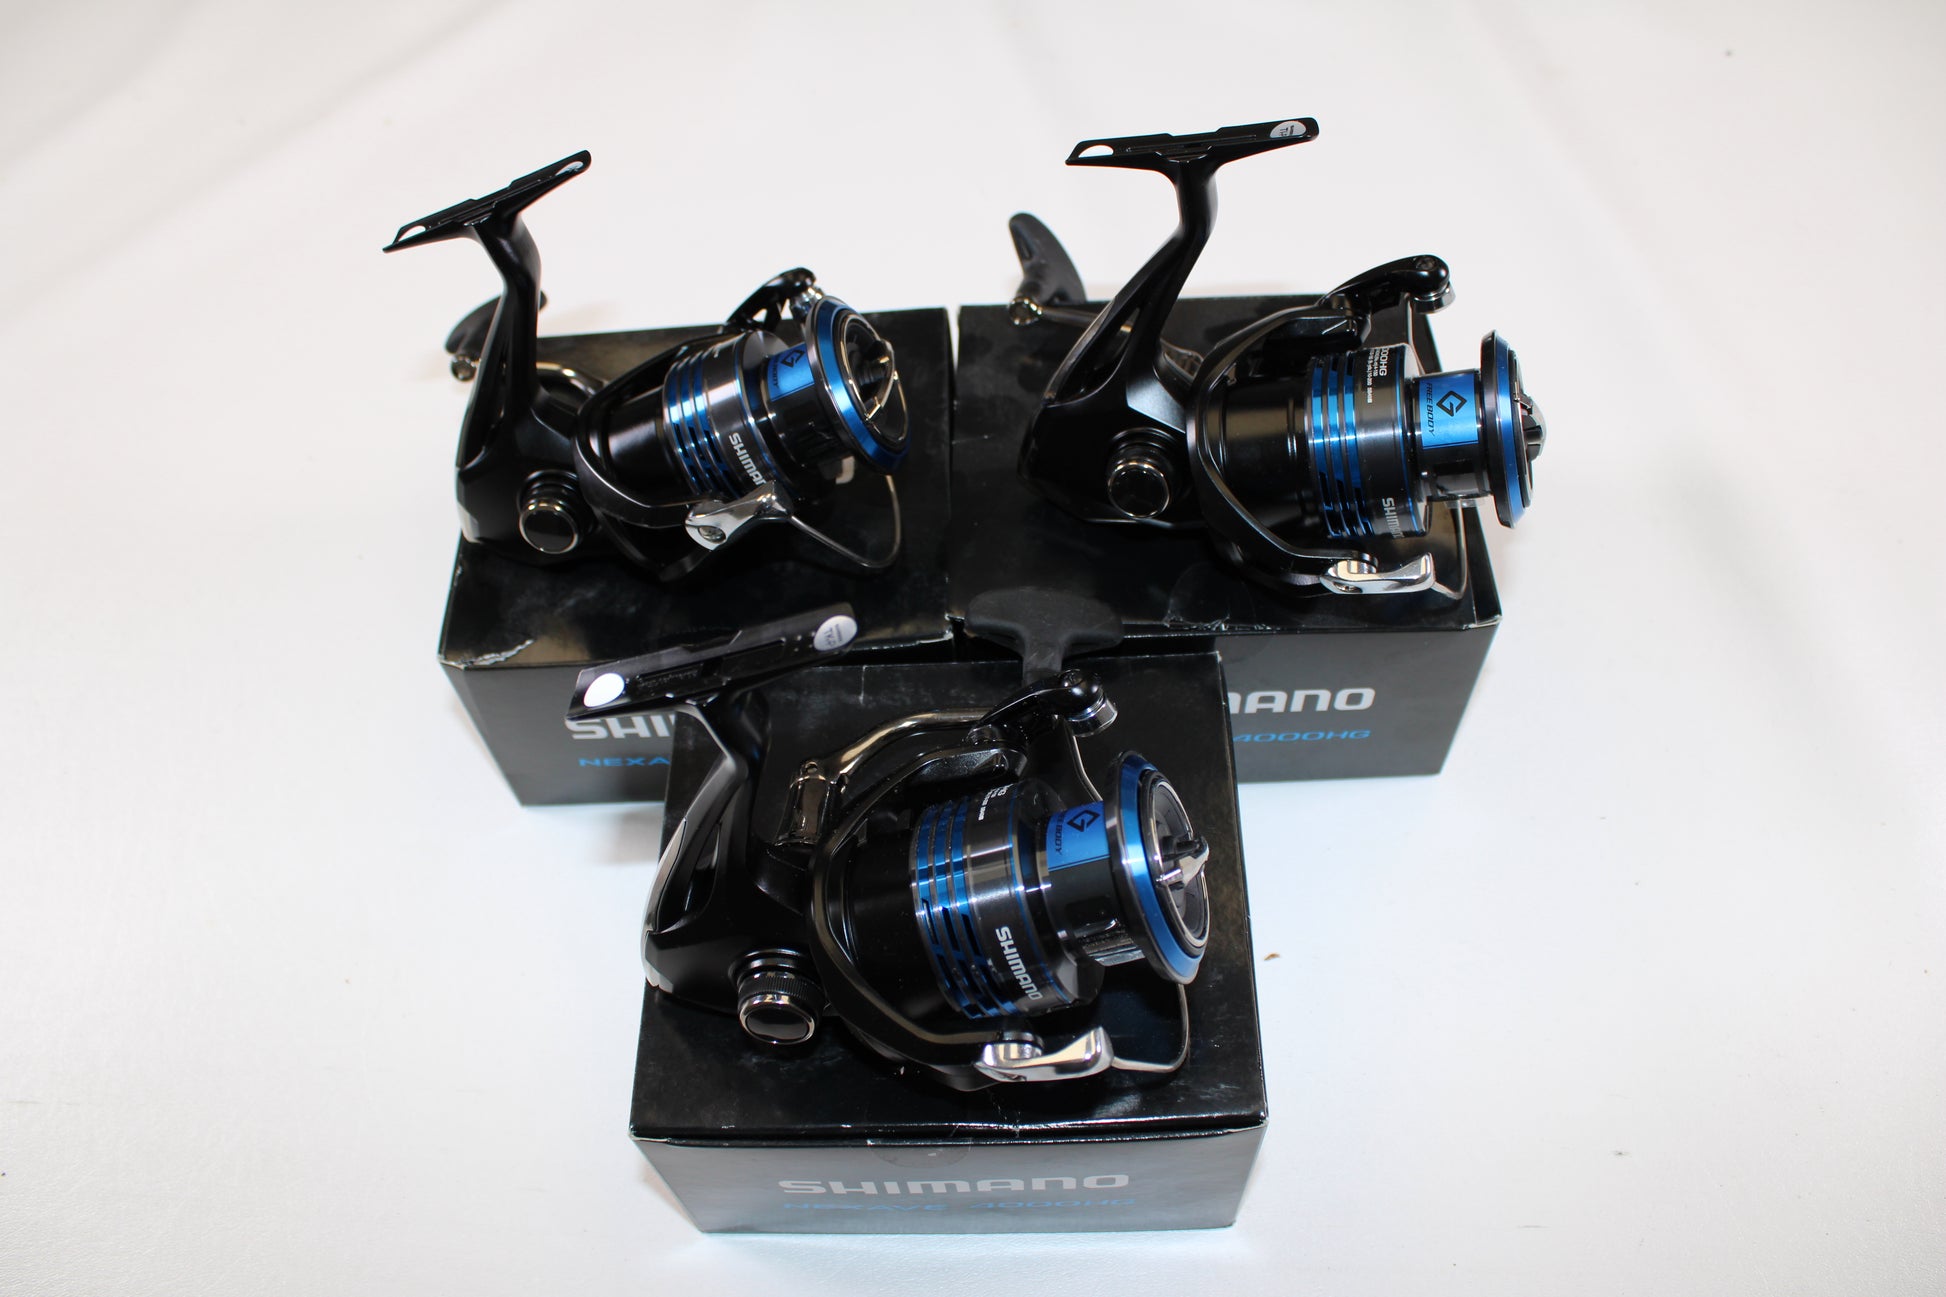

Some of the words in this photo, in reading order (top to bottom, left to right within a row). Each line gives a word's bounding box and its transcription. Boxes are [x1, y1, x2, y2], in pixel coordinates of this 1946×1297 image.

[1427, 406, 1435, 436] BODY
[1233, 730, 1371, 743] 4000HG
[995, 926, 1043, 1000] SHIMANO
[778, 1174, 1130, 1195] SHIMANO
[783, 1203, 949, 1211] NEXAVE
[969, 1199, 1136, 1210] 4000HG
